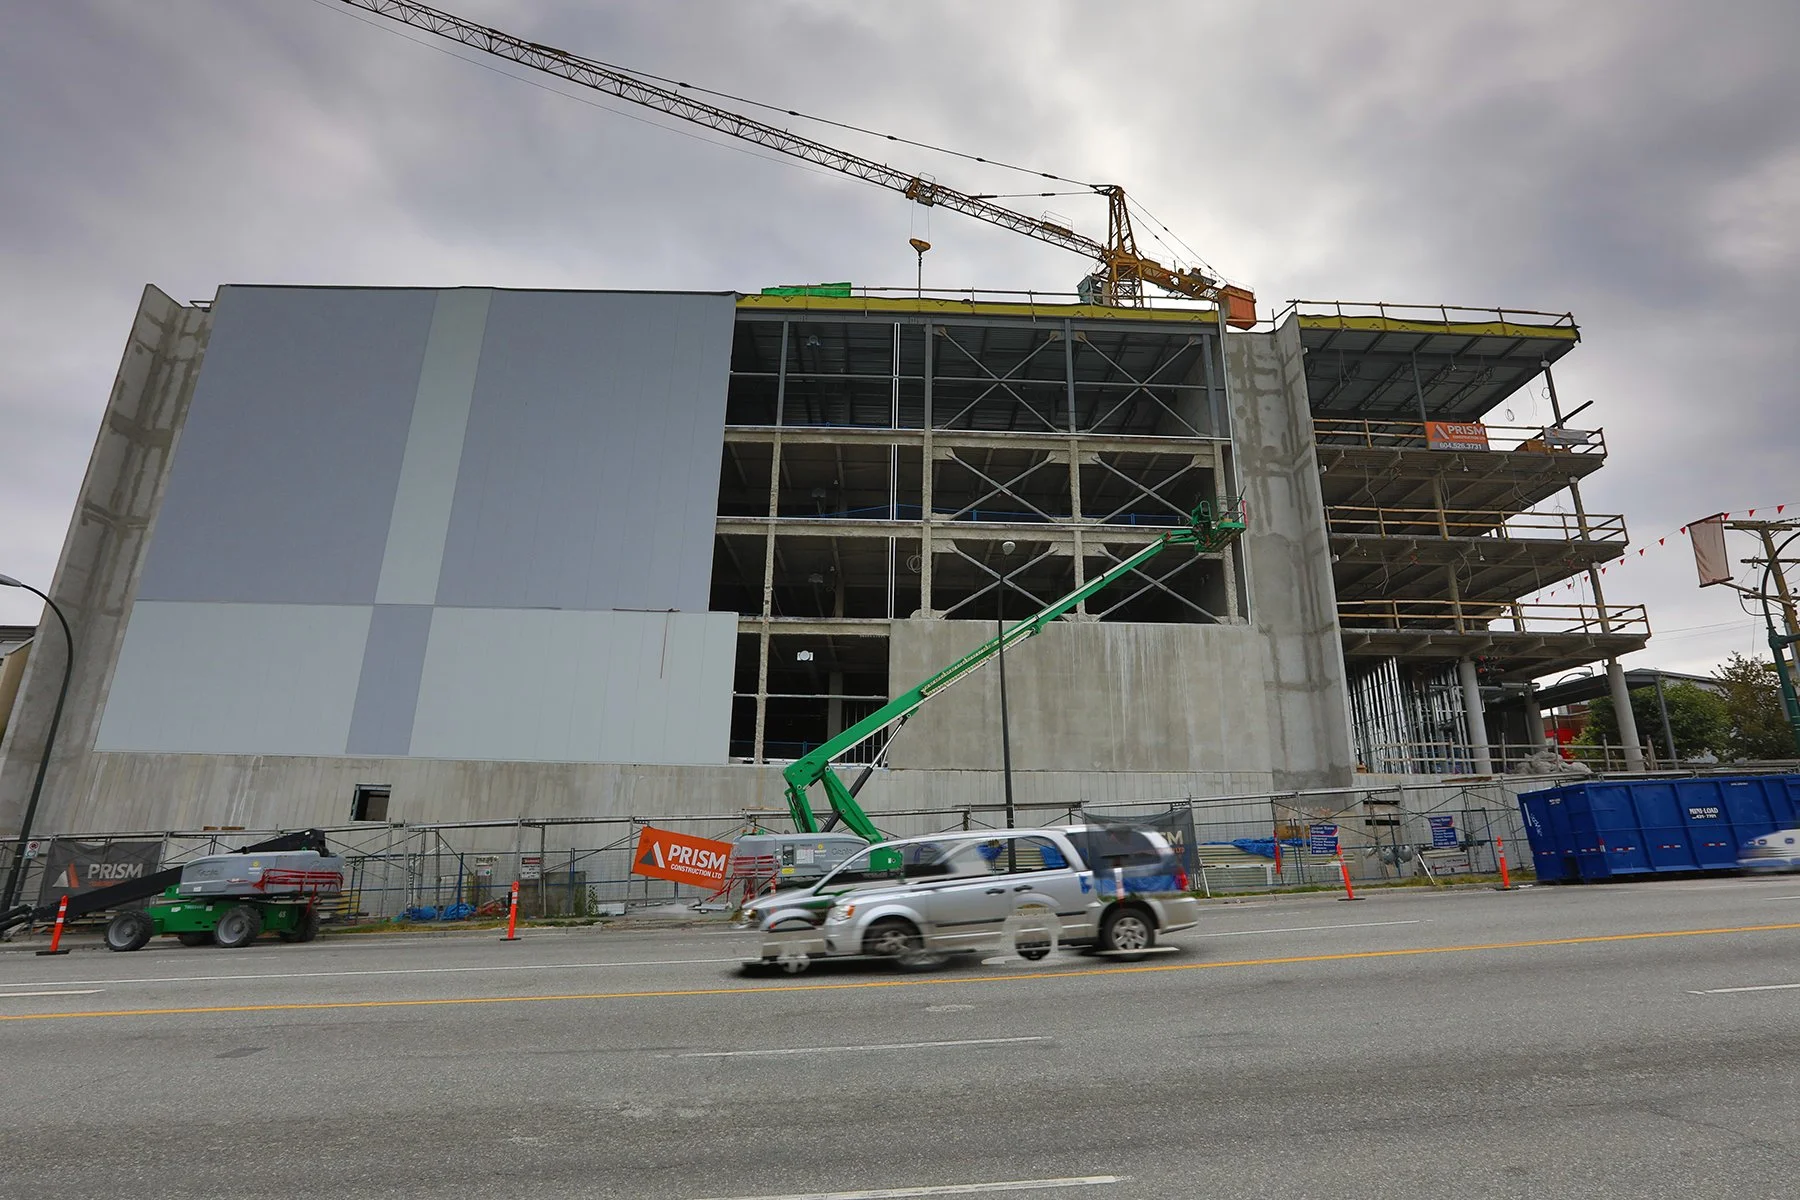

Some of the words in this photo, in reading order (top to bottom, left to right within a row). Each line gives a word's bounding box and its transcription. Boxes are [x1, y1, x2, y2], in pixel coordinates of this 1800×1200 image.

[1448, 425, 1486, 436] PRISM
[667, 844, 727, 872] PRISM
[87, 863, 143, 879] PRISM
[670, 863, 712, 877] CONSTRUCTION
[711, 872, 723, 880] LTD
